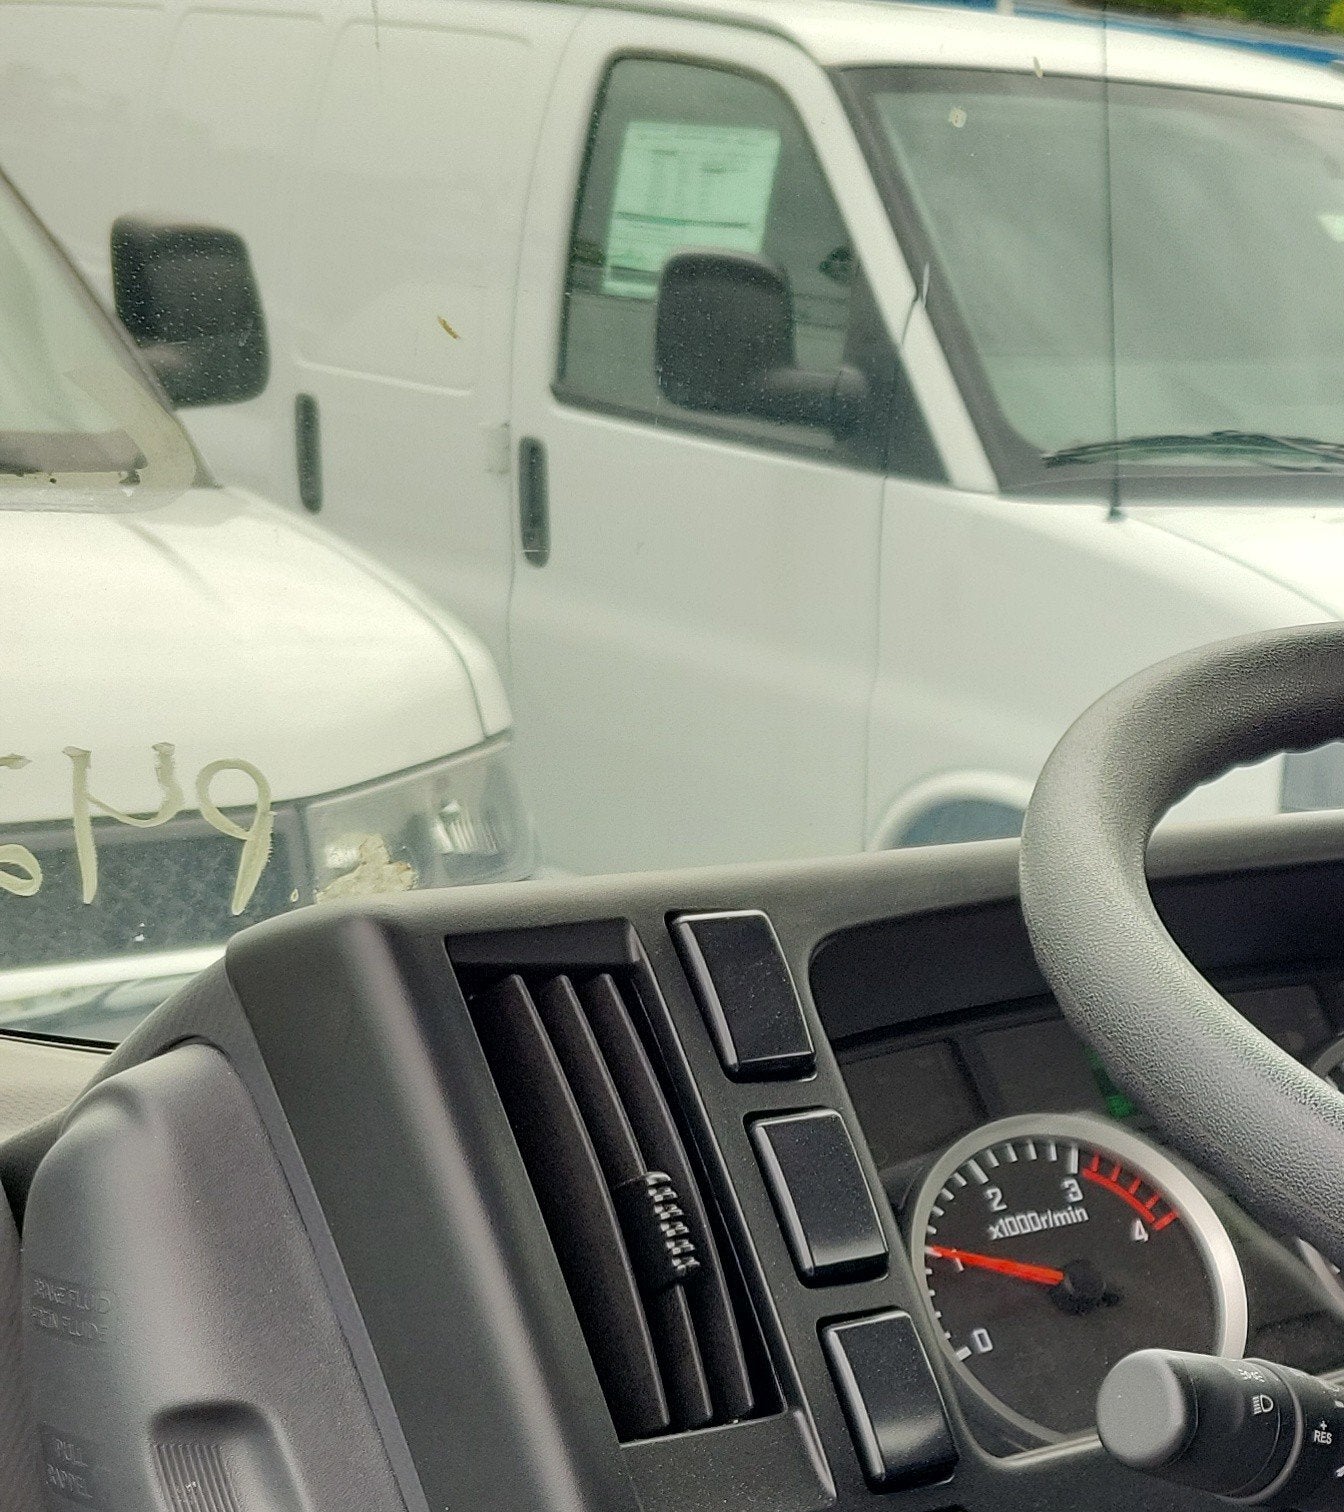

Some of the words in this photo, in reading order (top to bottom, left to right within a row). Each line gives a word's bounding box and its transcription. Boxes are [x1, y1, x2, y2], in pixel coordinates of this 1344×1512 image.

[985, 1187, 1008, 1213] 2
[1061, 1177, 1084, 1203] 3
[1131, 1218, 1150, 1243] 4
[970, 1327, 994, 1354] 0
[1313, 1429, 1333, 1445] RES
